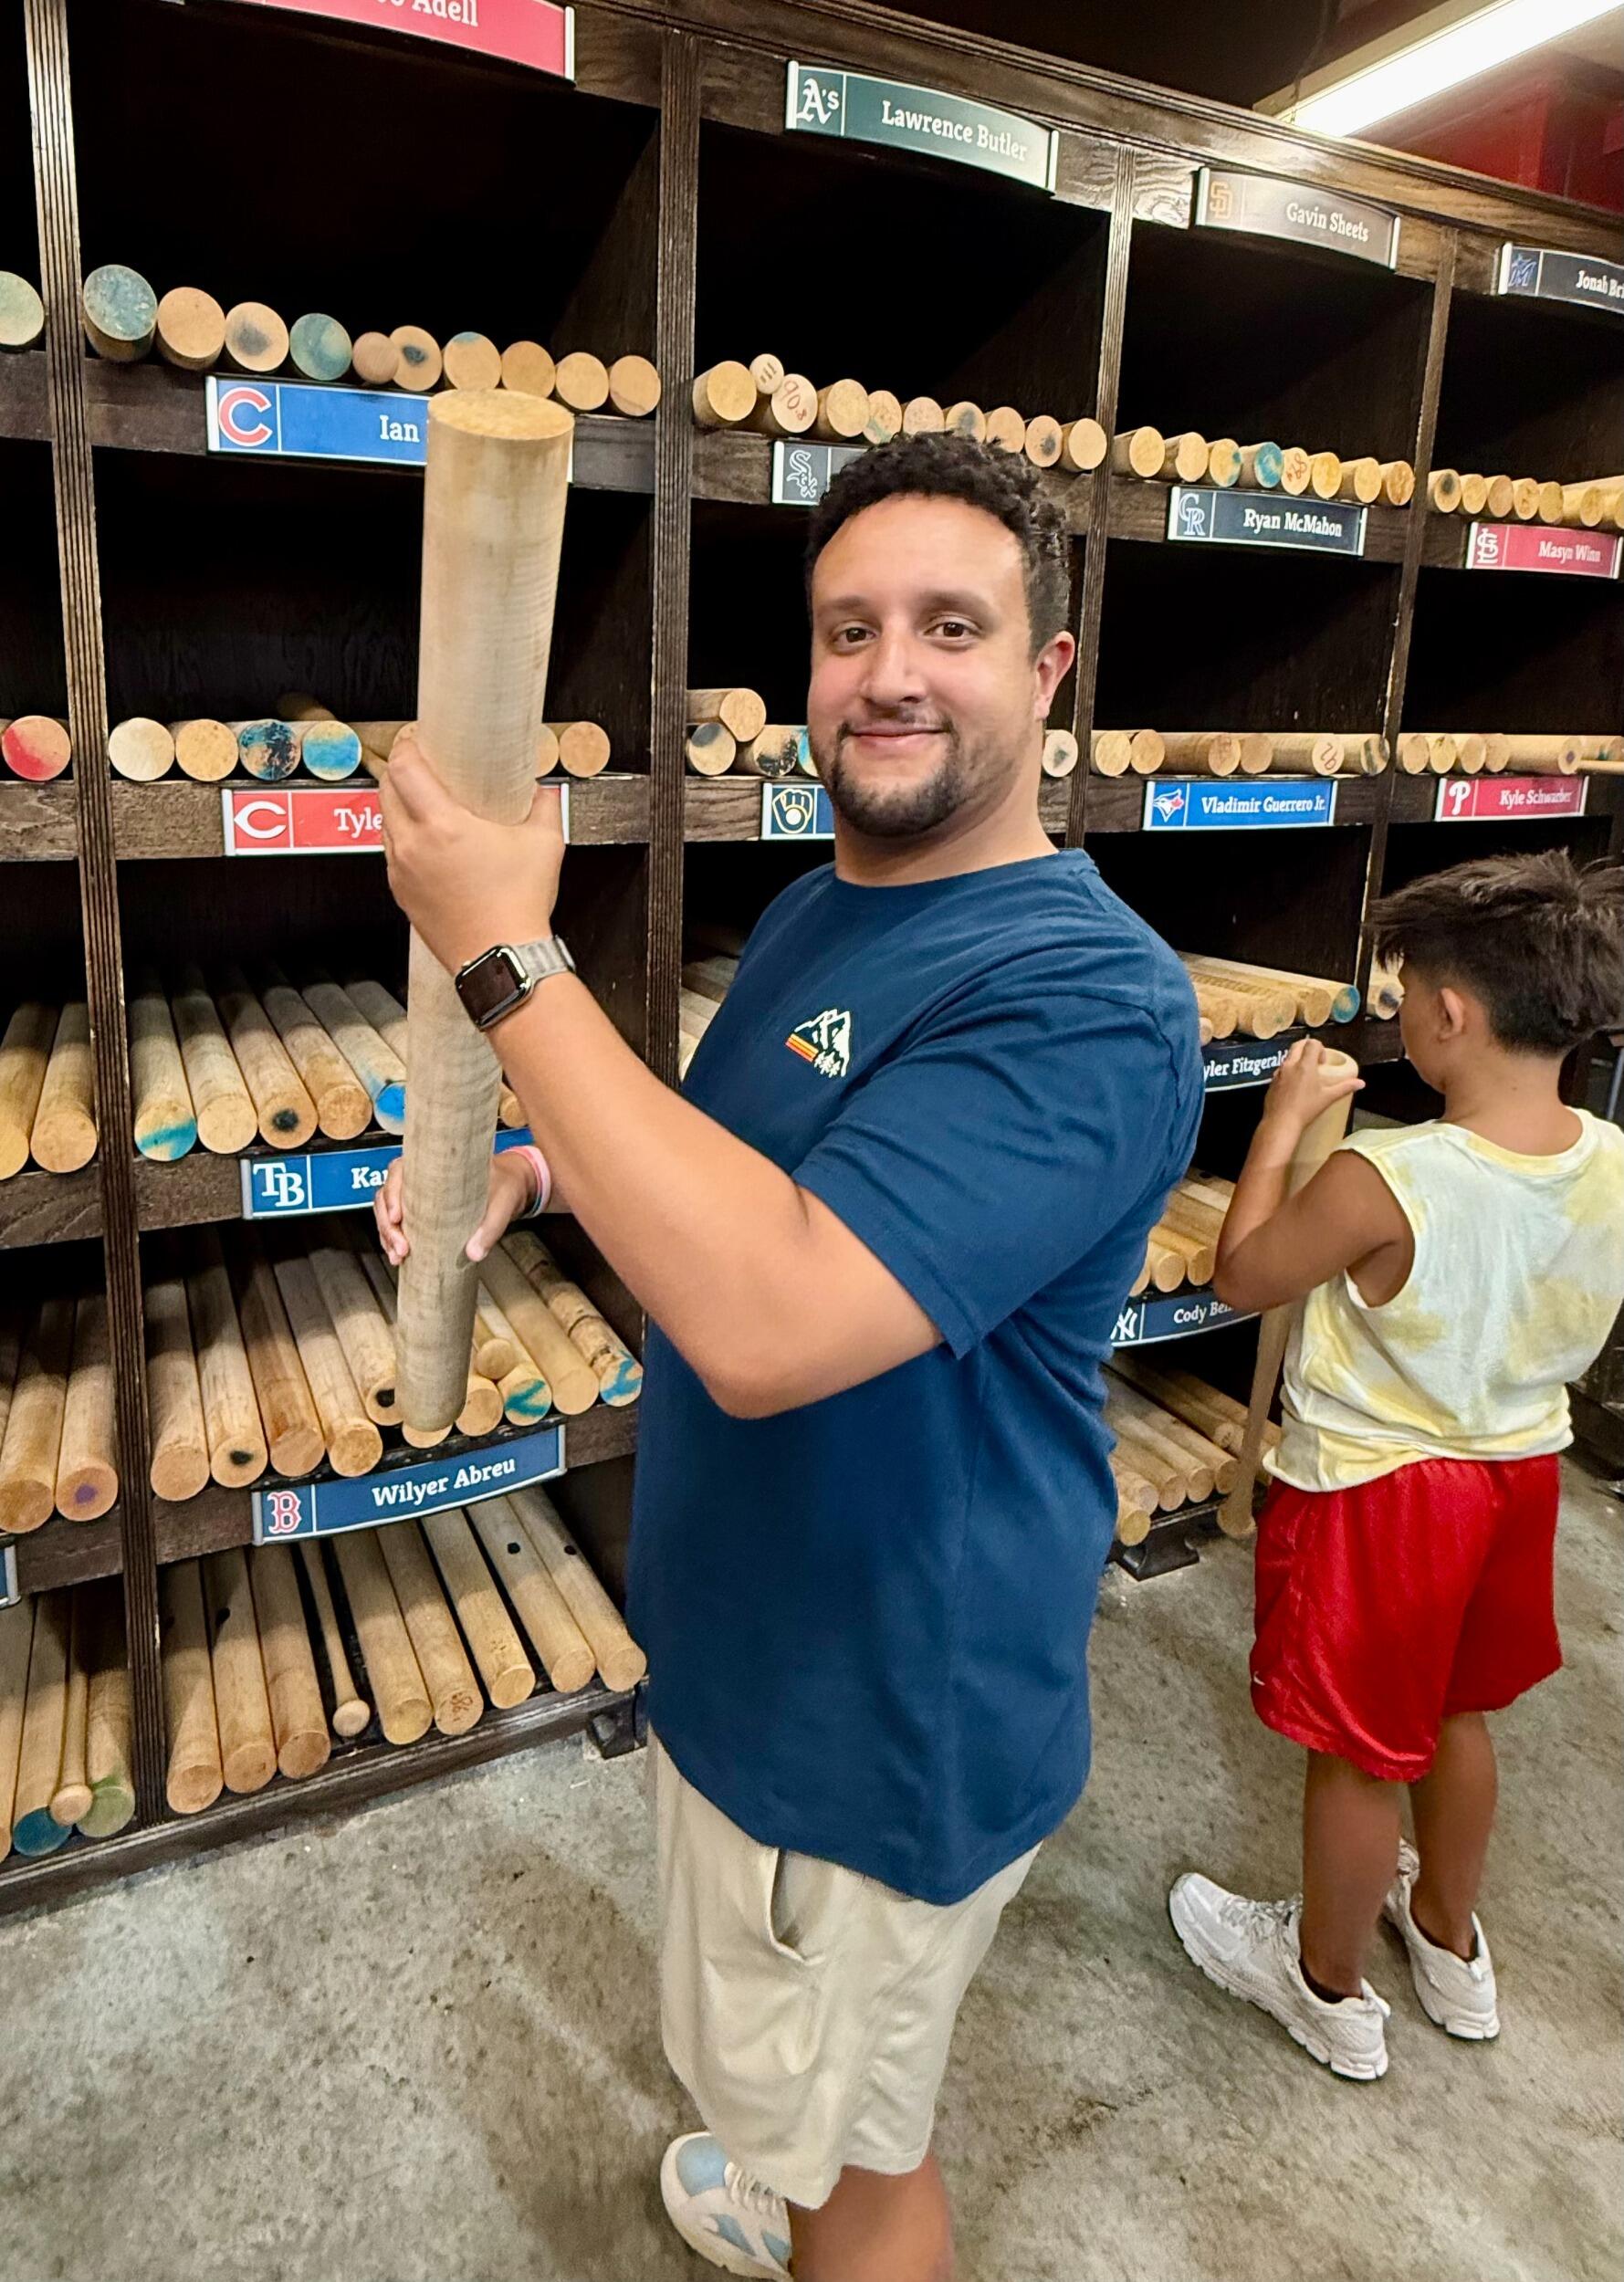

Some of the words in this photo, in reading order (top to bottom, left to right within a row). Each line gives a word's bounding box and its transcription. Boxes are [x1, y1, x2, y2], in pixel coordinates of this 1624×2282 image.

[882, 99, 972, 143] Lawrence
[977, 123, 1028, 162] Butler
[1209, 181, 1233, 220] SD
[1286, 202, 1327, 229] Gavin
[1329, 211, 1369, 243] Sheets
[1576, 270, 1608, 294] Jonah
[218, 386, 273, 447] C
[379, 414, 420, 443] Ian
[1179, 493, 1206, 537] CR
[1242, 508, 1281, 534] Ryan
[1283, 512, 1343, 538] McMahon
[1538, 540, 1573, 564] Masyn
[1201, 795, 1261, 814] Vladimir
[1263, 797, 1313, 813] Guerrero
[1314, 794, 1326, 811] Jr.
[1449, 780, 1472, 815] P
[1499, 789, 1525, 811] Kyle
[234, 801, 287, 839] C
[253, 1162, 305, 1207] TB
[1173, 1304, 1207, 1324] Cody
[372, 1475, 449, 1506] Wilyer
[453, 1459, 516, 1489] Abreu
[267, 1491, 302, 1534] B
